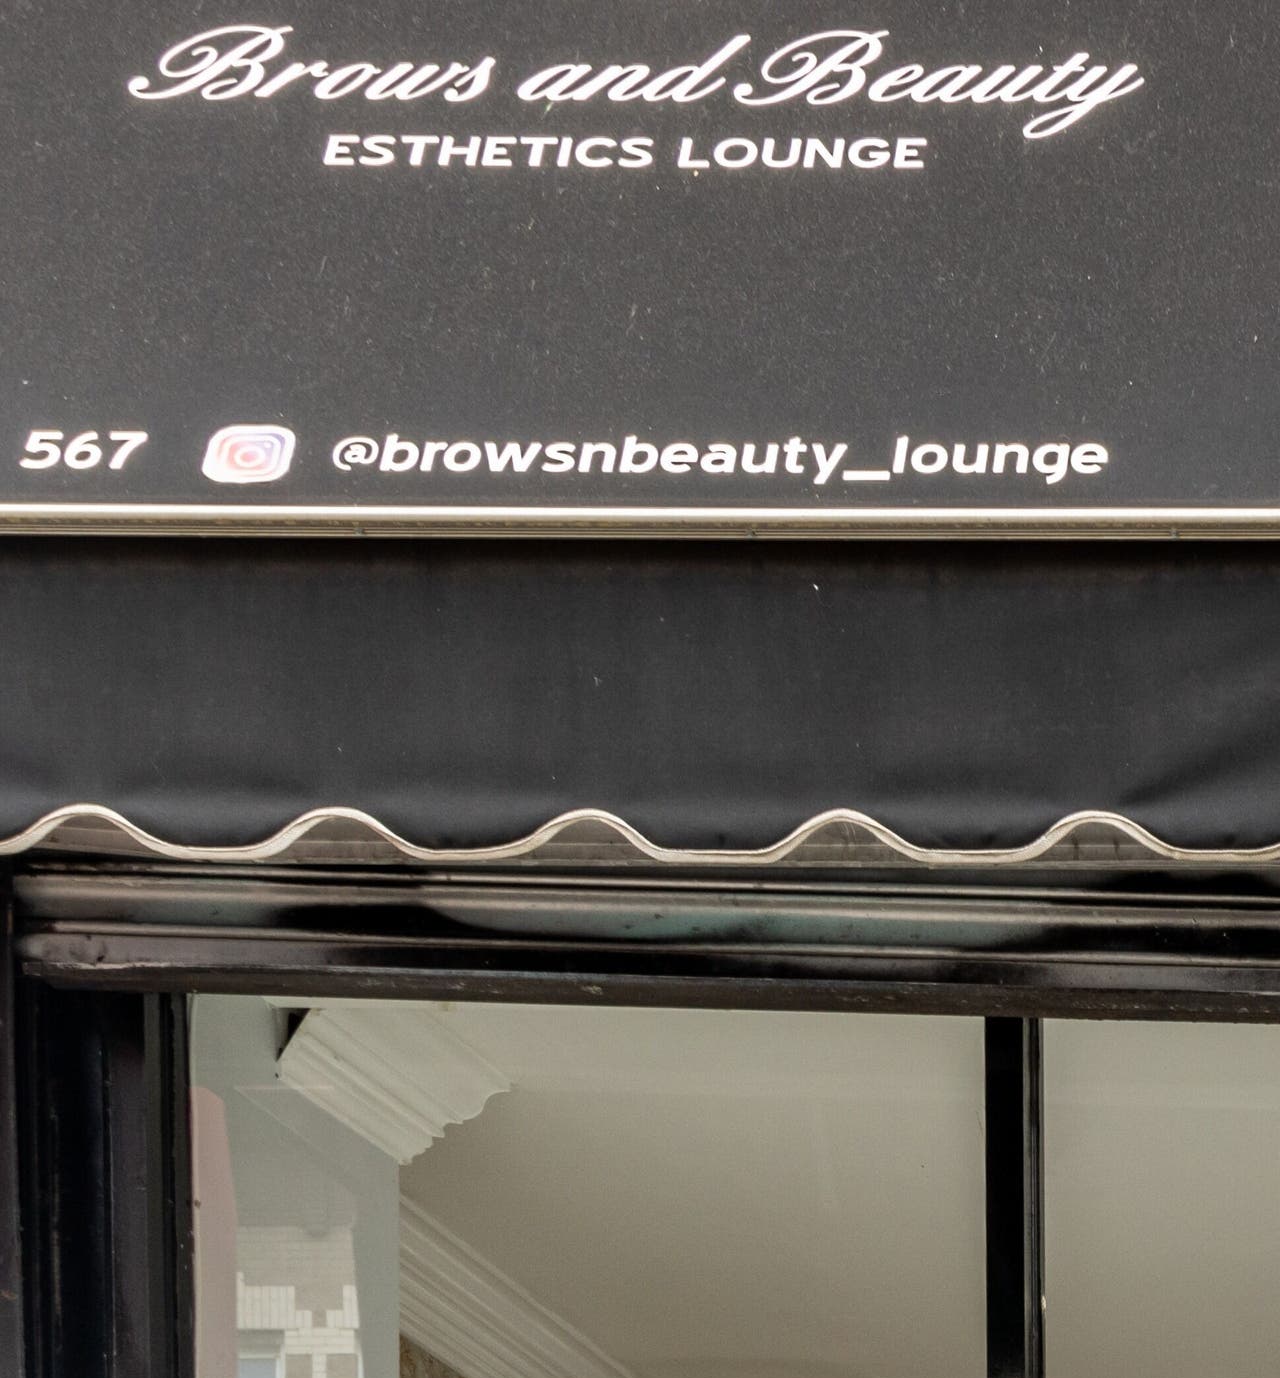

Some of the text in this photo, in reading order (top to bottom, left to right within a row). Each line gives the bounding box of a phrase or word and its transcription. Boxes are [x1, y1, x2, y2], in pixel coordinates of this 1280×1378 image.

[128, 25, 1144, 139] Brows and Beauty
[322, 134, 928, 170] ESTHETICS LOUNGE
[19, 431, 149, 471] 567
[331, 434, 1110, 486] @browsnbeauty_lounge
